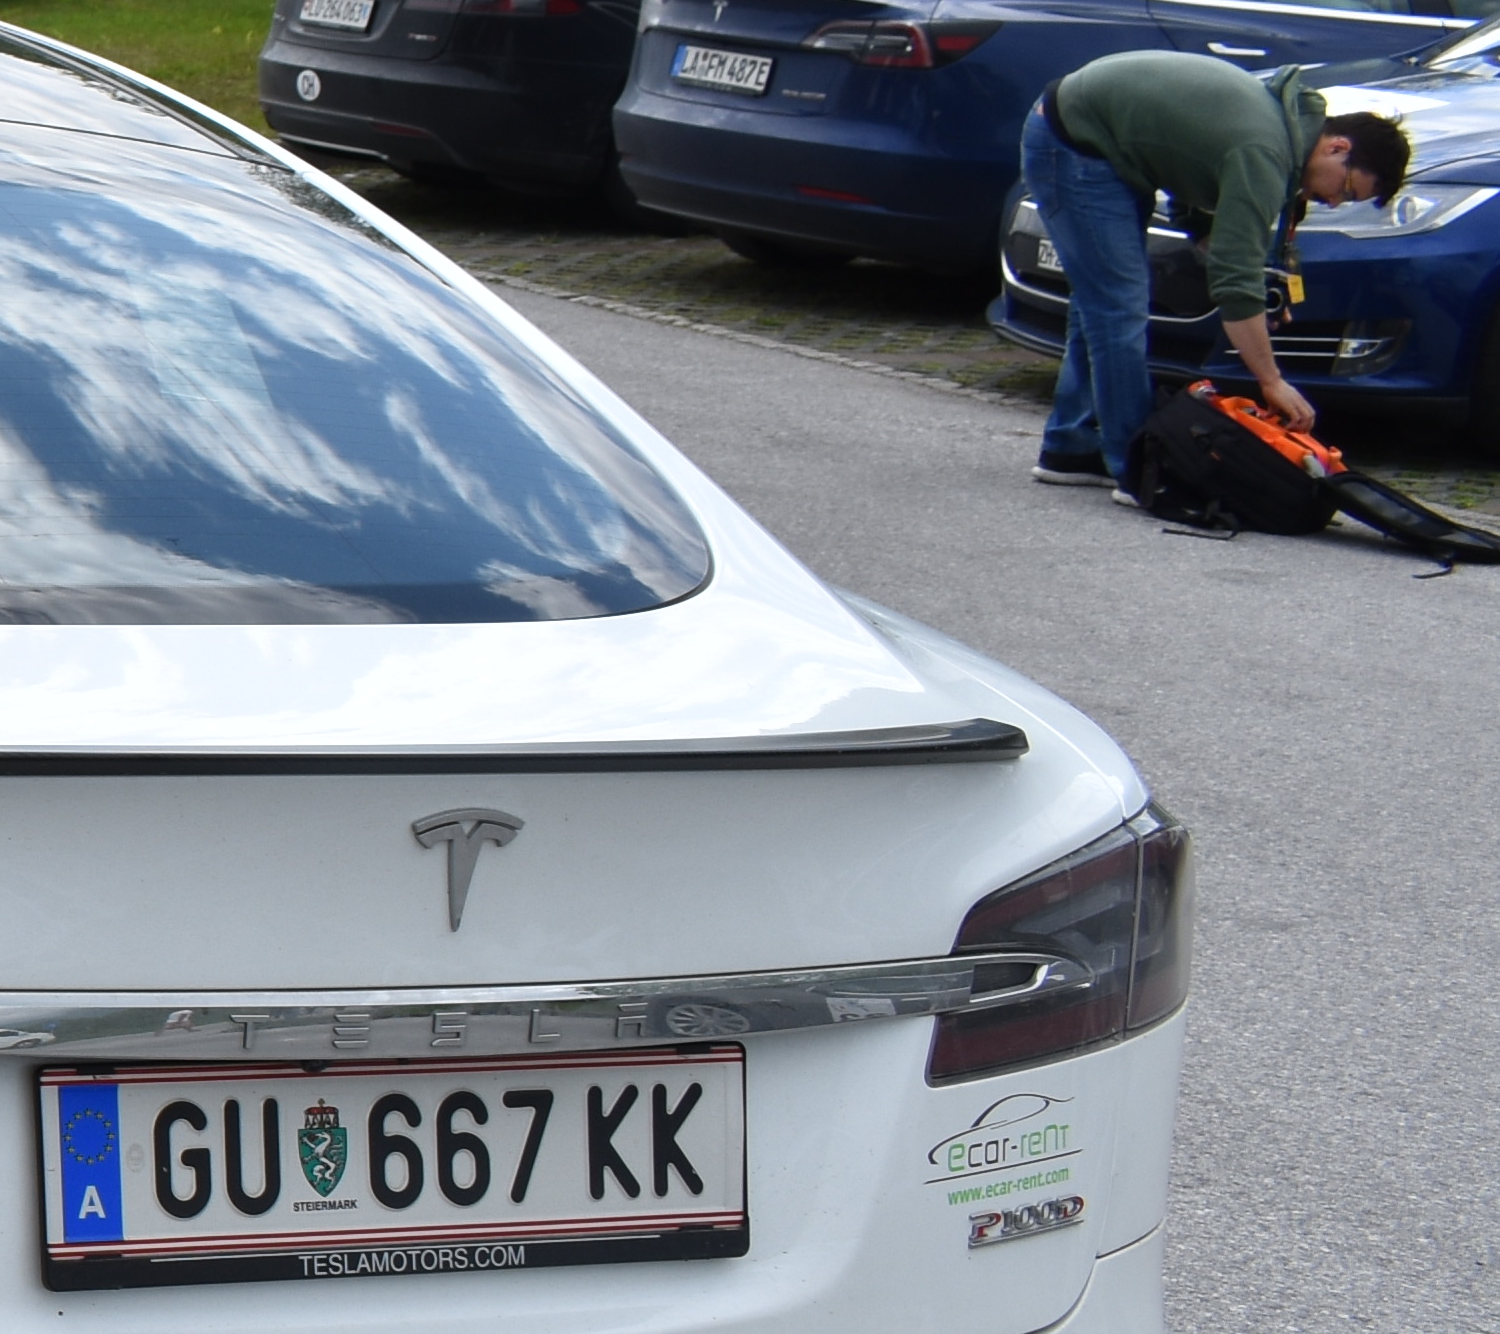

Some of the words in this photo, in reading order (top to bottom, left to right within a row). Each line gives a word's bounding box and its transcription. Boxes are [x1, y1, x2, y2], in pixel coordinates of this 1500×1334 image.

[229, 1002, 650, 1051] TESLA
[152, 1097, 281, 1219] GU
[367, 1089, 555, 1210] 667
[586, 1082, 704, 1202] KK
[78, 1185, 106, 1219] A
[293, 1200, 358, 1212] STEIERMARK
[948, 1168, 1070, 1206] www.ecar-rent.com
[969, 1195, 1085, 1241] P100D
[298, 1245, 526, 1278] TESLAMOTORS.COM
